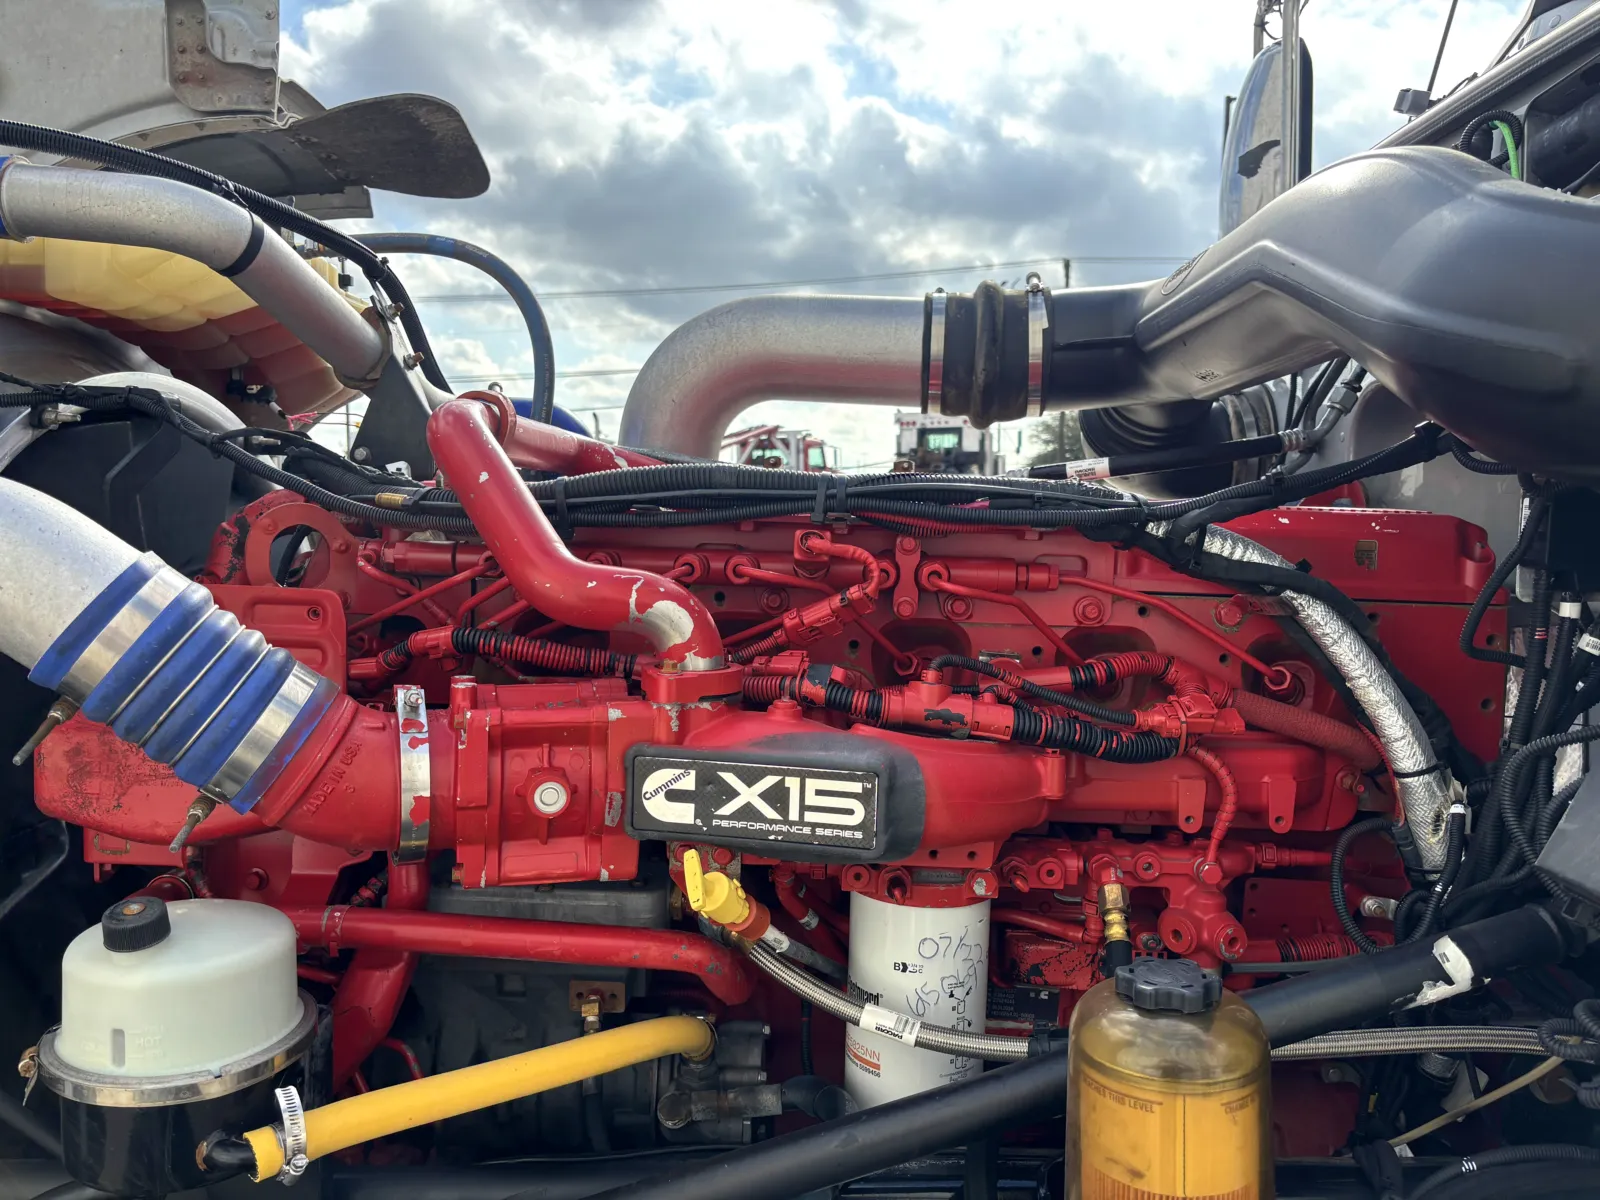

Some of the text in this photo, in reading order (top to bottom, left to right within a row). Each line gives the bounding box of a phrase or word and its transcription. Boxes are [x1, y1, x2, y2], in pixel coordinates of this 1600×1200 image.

[643, 768, 691, 801] Cummins
[713, 771, 866, 827] X15
[712, 819, 864, 839] PERFORMANCE SERIES
[1108, 1091, 1126, 1106] THIS
[1128, 1097, 1156, 1114] LEVEL
